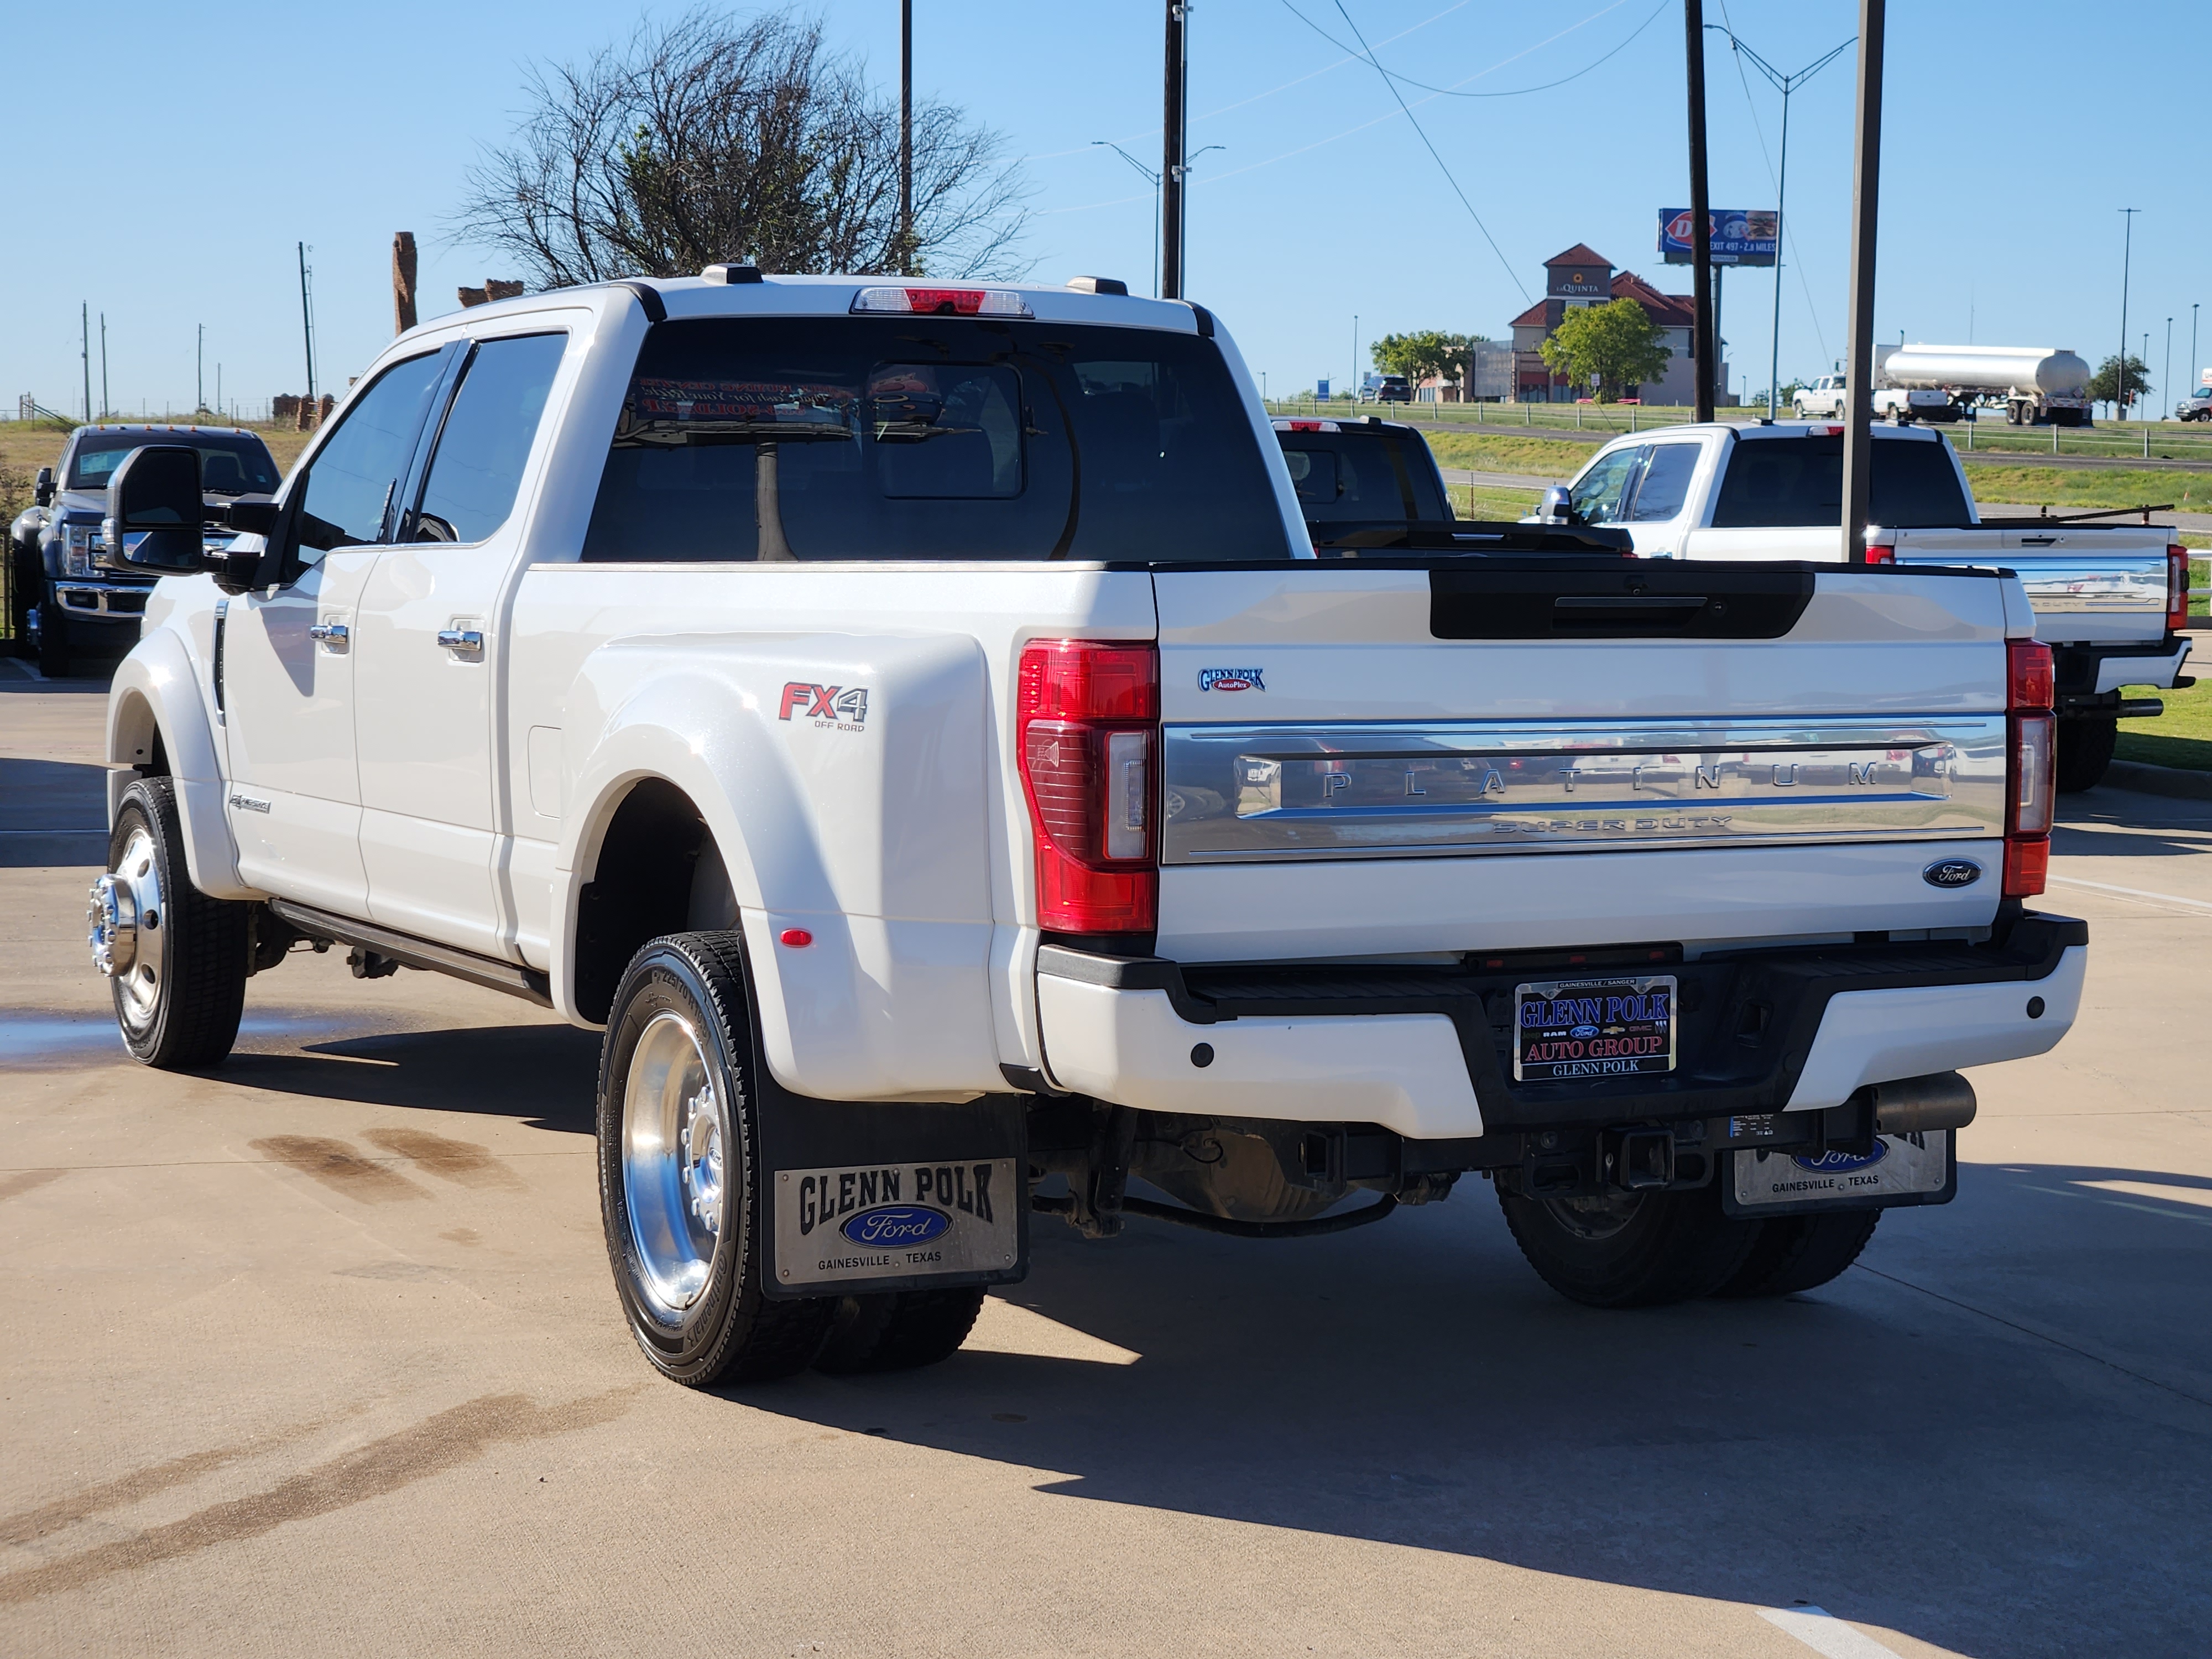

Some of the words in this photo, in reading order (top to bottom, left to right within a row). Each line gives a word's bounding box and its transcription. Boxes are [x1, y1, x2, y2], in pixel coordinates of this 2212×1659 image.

[1710, 242, 1725, 251] EXIT
[1726, 242, 1739, 251] 497
[1756, 243, 1775, 251] MILES
[1563, 284, 1599, 294] QUINTA
[1198, 668, 1234, 692] GLENN
[1237, 668, 1266, 691] POLK
[779, 681, 868, 723] FX4
[815, 721, 834, 729] OFF
[837, 723, 865, 732] ROAD
[1323, 761, 1877, 797] PLATINUM
[1494, 818, 1626, 833] SUPER
[1636, 816, 1733, 830] DUTY
[1939, 865, 1971, 881] Ford
[1521, 998, 1602, 1028] GLENN
[1606, 994, 1669, 1022] POLK
[1575, 1027, 1594, 1037] Ford
[1525, 1041, 1584, 1061] AUTO
[1589, 1036, 1662, 1057] GROUP
[1553, 1062, 1600, 1077] GLENN
[1603, 1060, 1639, 1073] POLK
[1772, 1179, 1834, 1192] GAINESVILLE
[1849, 1175, 1879, 1187] TEXAS
[800, 1168, 900, 1237] GLENN
[915, 1164, 994, 1224] POLK
[862, 1213, 932, 1240] Ford
[818, 1255, 890, 1270] GAINESVILLE
[906, 1251, 942, 1264] TEXAS
